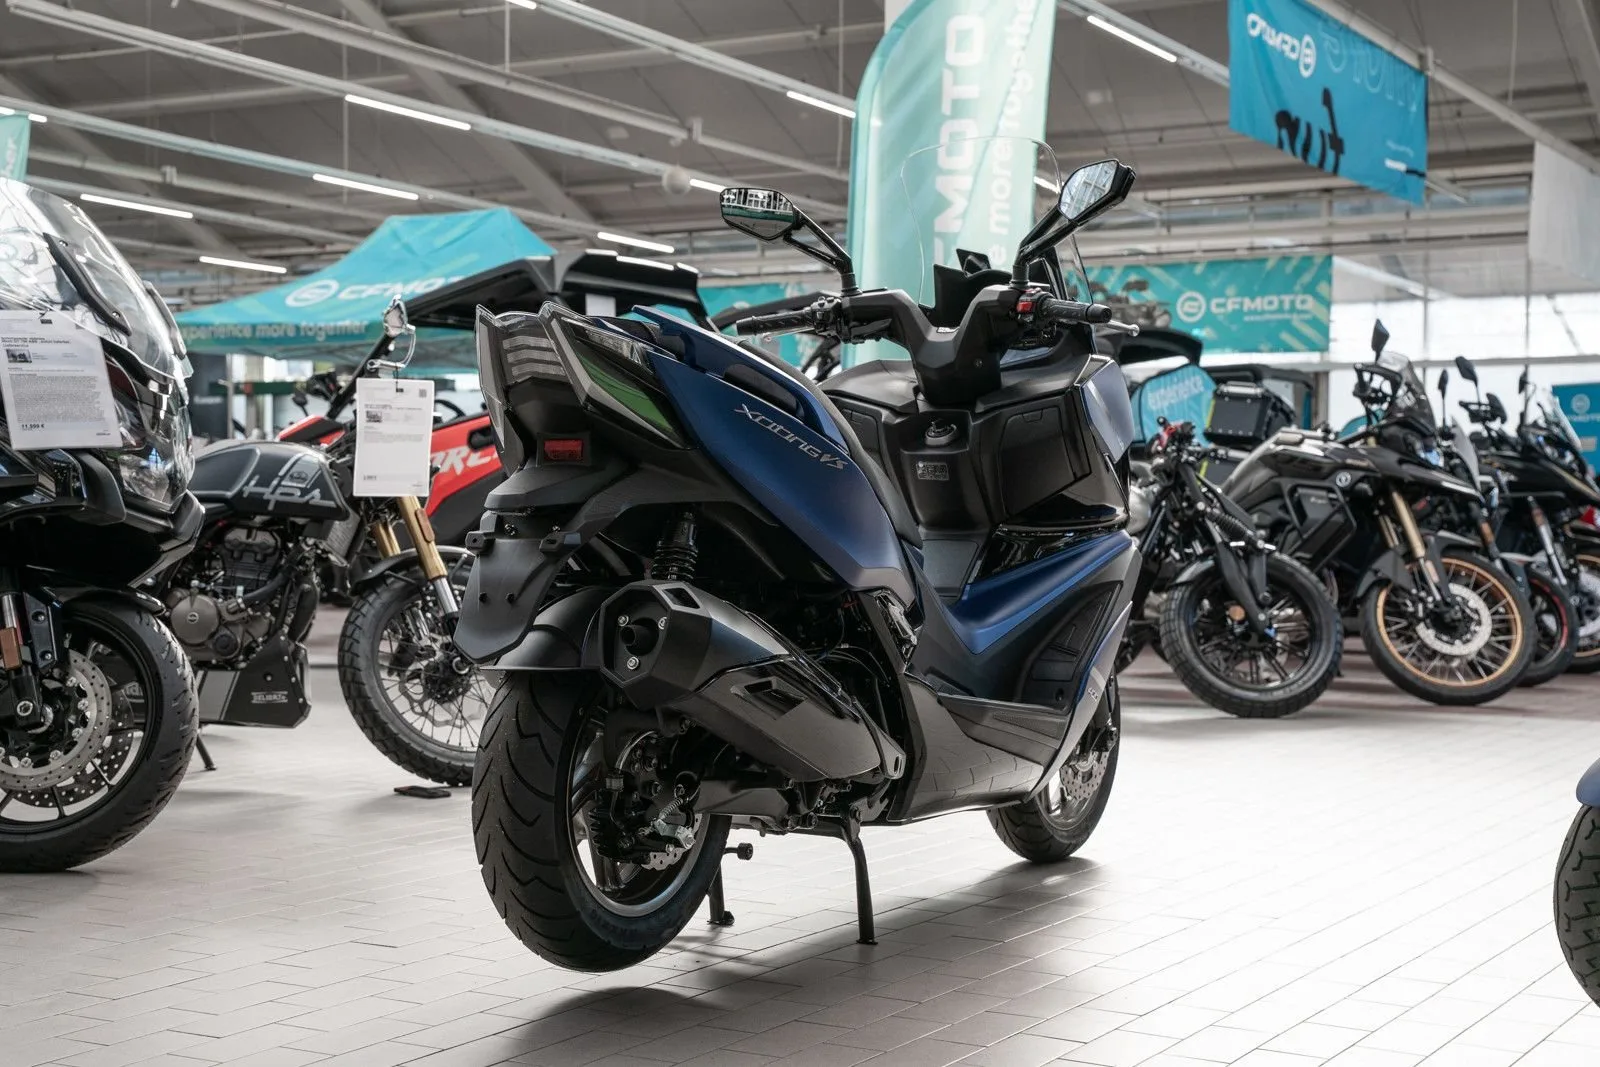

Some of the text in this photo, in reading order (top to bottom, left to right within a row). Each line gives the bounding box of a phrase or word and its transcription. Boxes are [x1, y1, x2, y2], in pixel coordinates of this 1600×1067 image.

[987, 138, 1013, 235] more
[1210, 293, 1315, 314] CFMOTO
[256, 323, 297, 337] more
